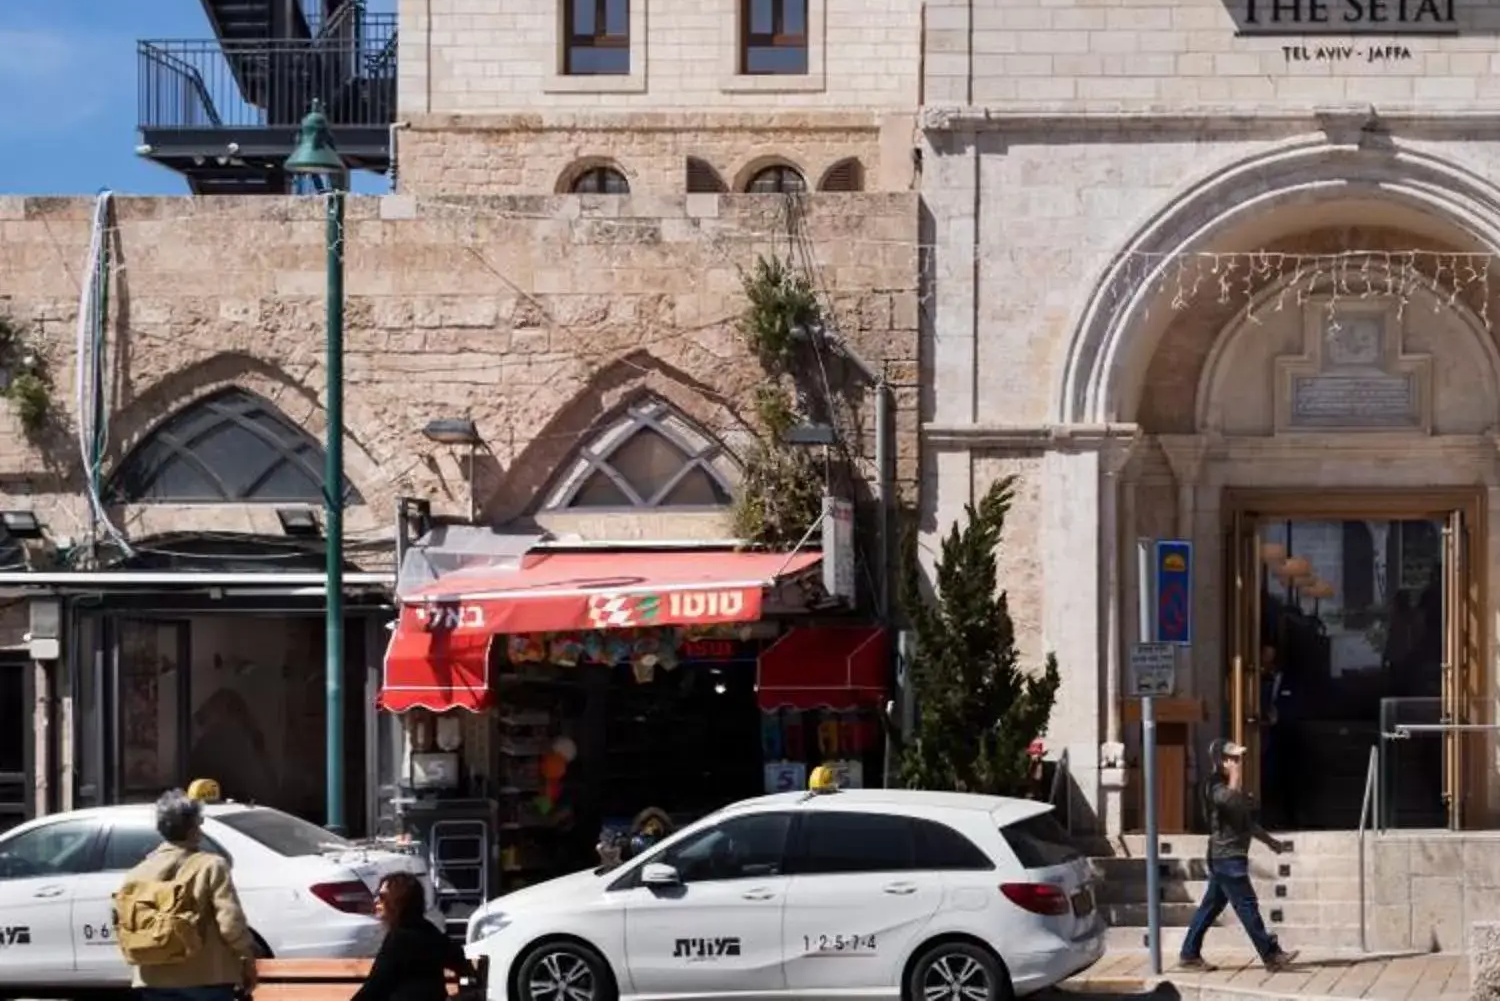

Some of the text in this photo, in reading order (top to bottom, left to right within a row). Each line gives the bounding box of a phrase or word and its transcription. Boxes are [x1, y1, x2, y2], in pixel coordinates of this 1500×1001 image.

[1281, 46, 1310, 62] TEL
[1316, 46, 1353, 61] AVIV
[1367, 46, 1412, 63] JAFFA
[669, 591, 743, 618] טוטו
[415, 605, 485, 628] באלי
